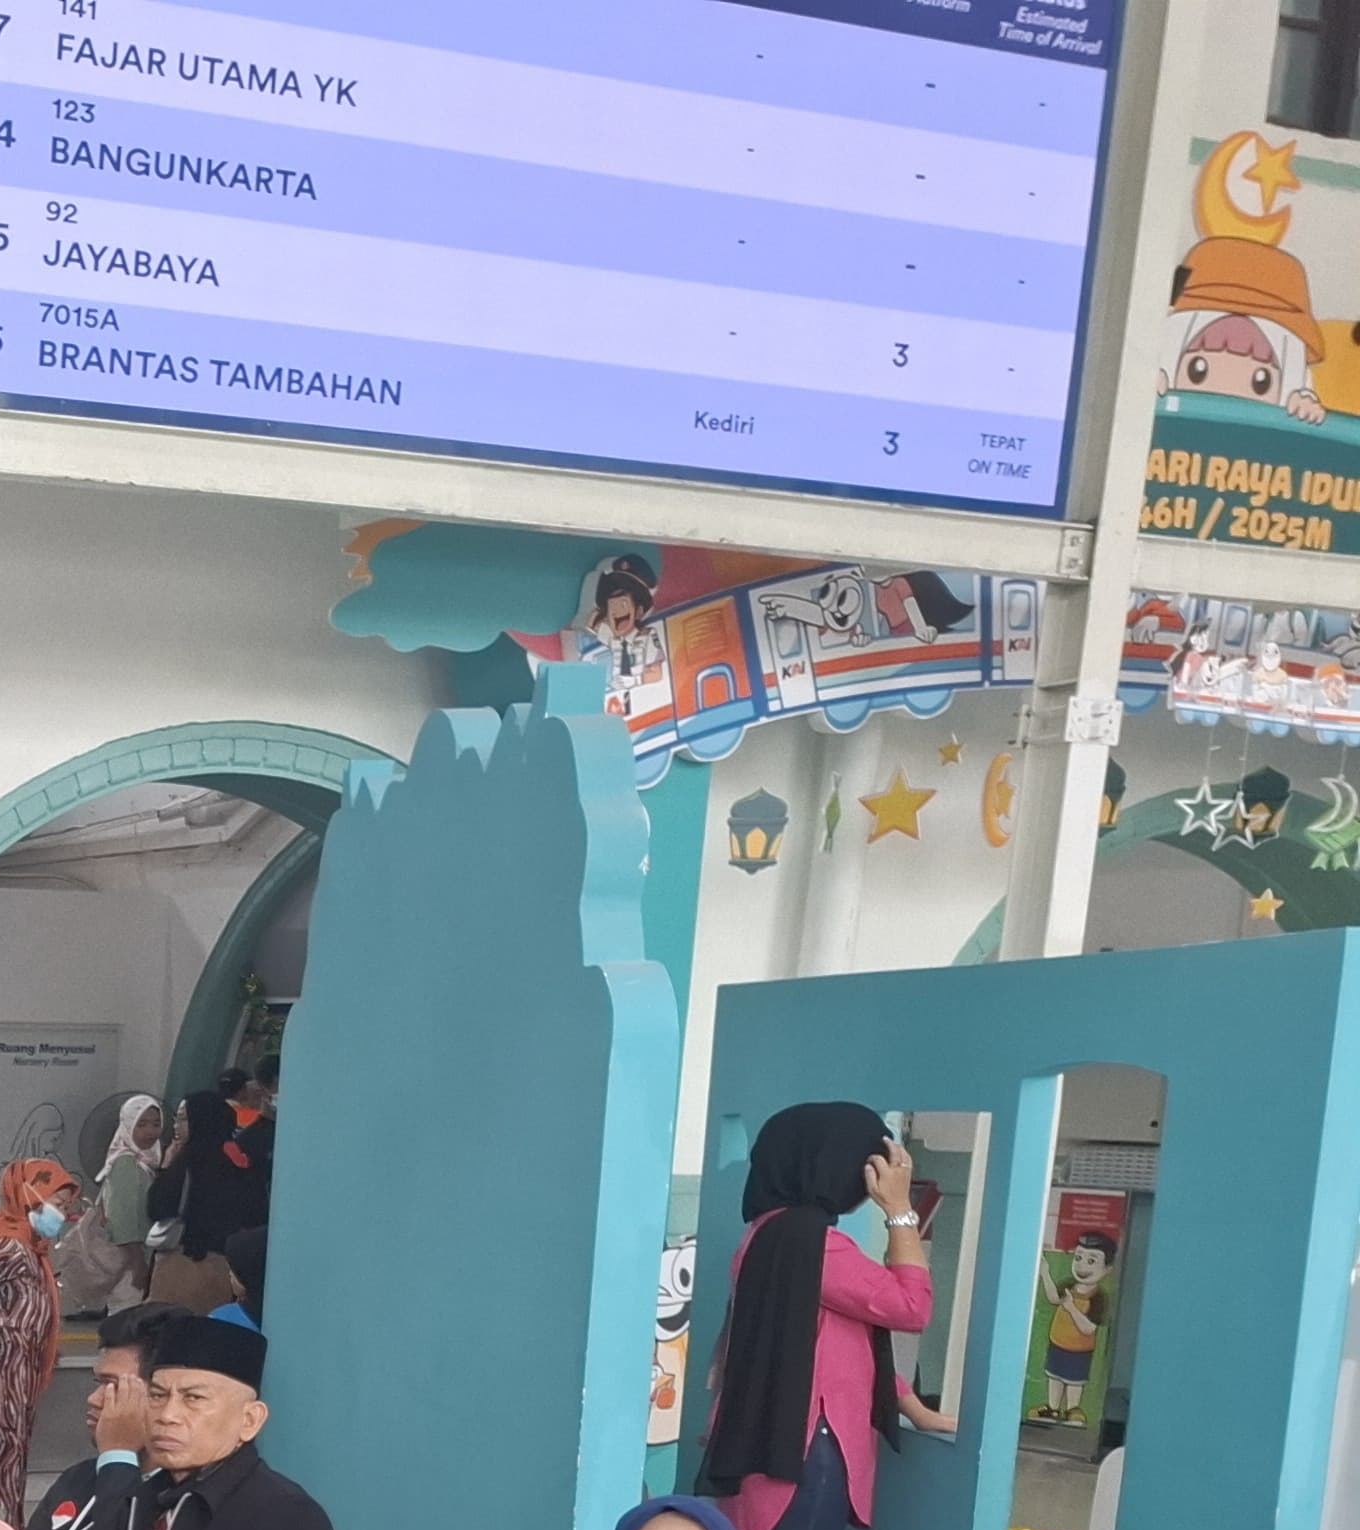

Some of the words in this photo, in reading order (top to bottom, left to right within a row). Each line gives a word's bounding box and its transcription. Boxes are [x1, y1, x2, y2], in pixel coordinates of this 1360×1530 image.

[1016, 6, 1089, 33] Estimated
[998, 21, 1034, 43] Time
[1036, 31, 1051, 46] of
[1052, 33, 1104, 55] Arrival
[55, 34, 167, 78] FAJAR
[177, 51, 303, 99] UTAMA
[312, 73, 360, 107] YK
[51, 99, 96, 124] 123
[49, 136, 318, 200] BANGUNKARTA
[45, 202, 79, 224] 92
[42, 240, 221, 288] JAYABAYA
[39, 302, 121, 332] 7015A
[892, 343, 910, 368] 3
[37, 340, 199, 384] BRANTAS
[209, 359, 403, 406] TAMBAHAN
[694, 410, 755, 436] Kediri
[883, 431, 900, 456] 3
[980, 433, 1027, 452] TEPAT
[967, 459, 991, 475] ON
[995, 462, 1032, 479] TIME
[1145, 449, 1202, 487] ARI
[1229, 506, 1332, 550] 2025M
[38, 1042, 96, 1056] Menyusui
